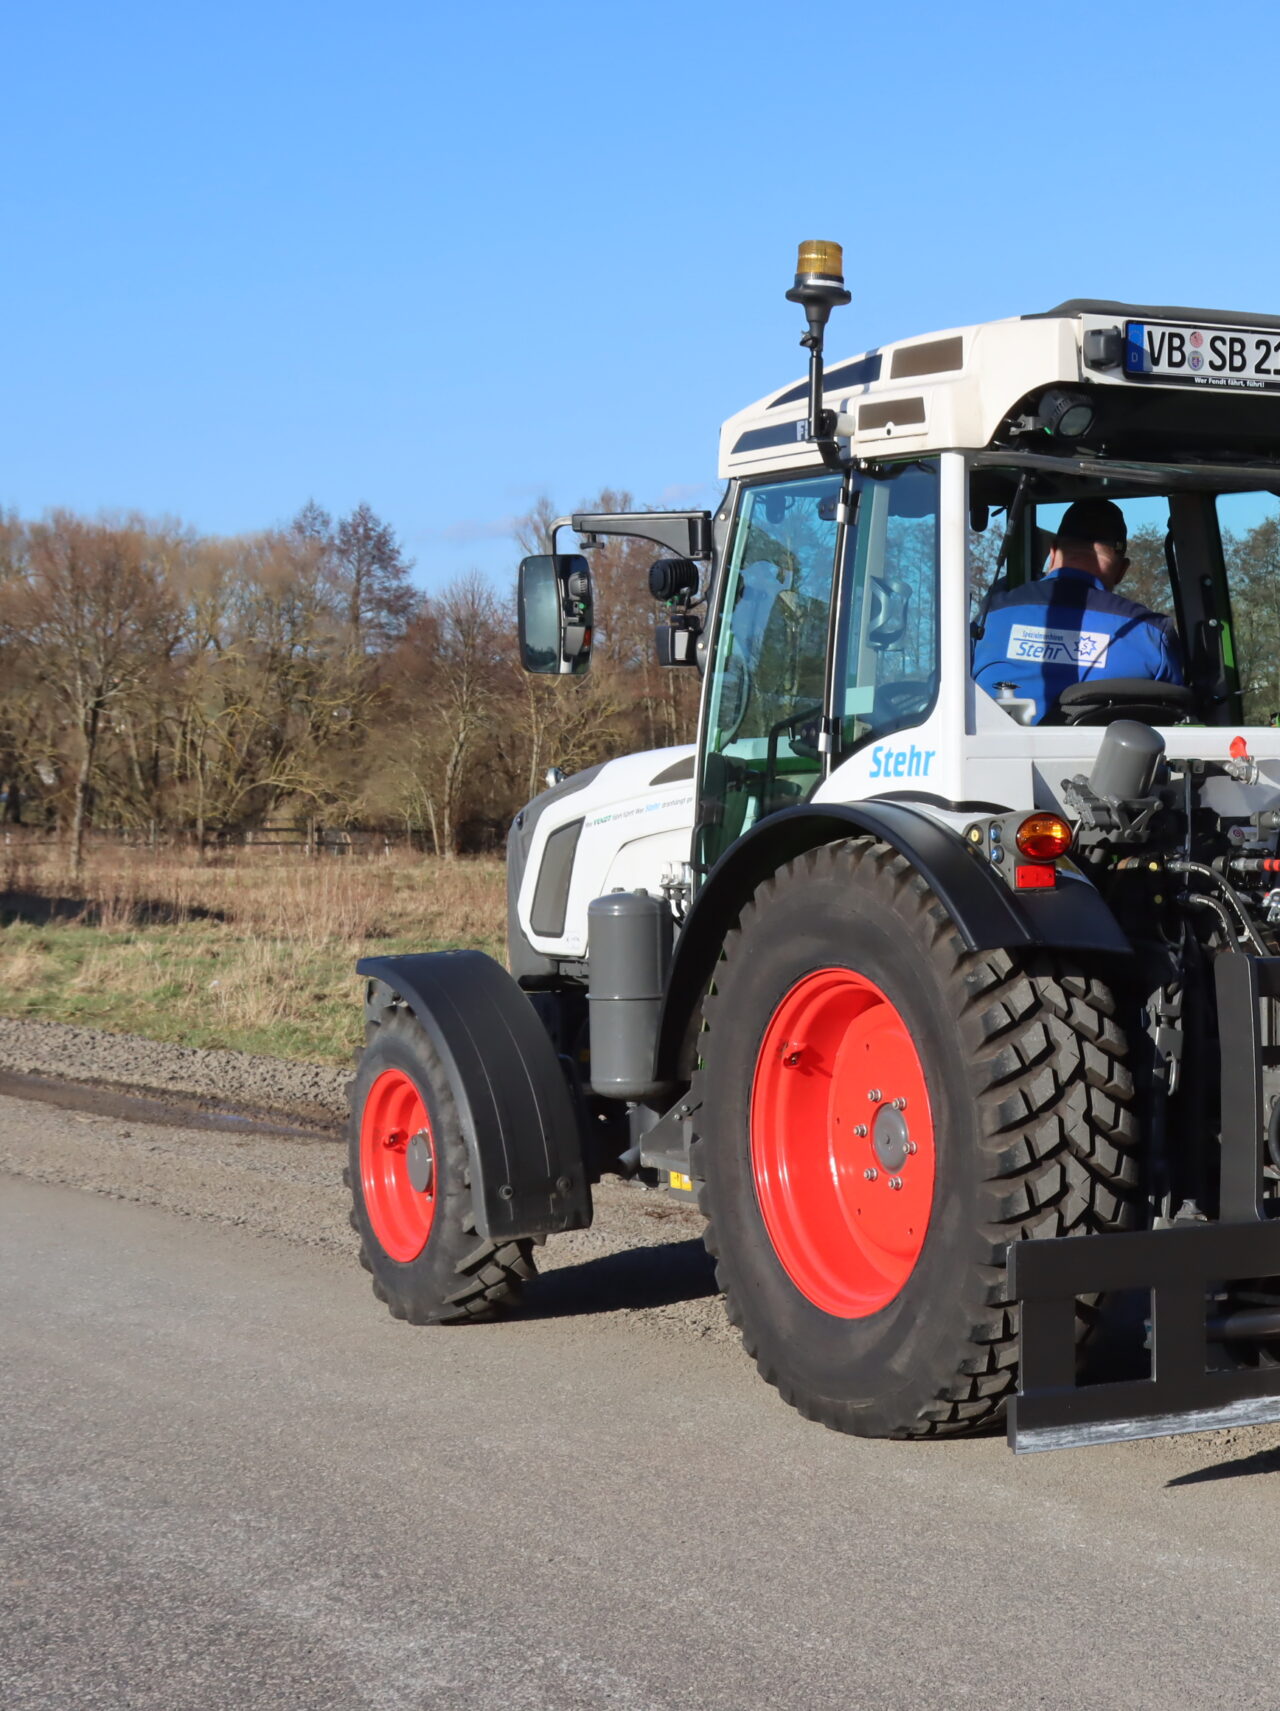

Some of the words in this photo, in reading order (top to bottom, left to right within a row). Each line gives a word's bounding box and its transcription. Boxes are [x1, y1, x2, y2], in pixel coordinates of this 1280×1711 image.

[1147, 331, 1186, 368] VB
[1209, 335, 1247, 372] SB
[1016, 642, 1062, 660] Stehr
[869, 744, 936, 778] Stehr
